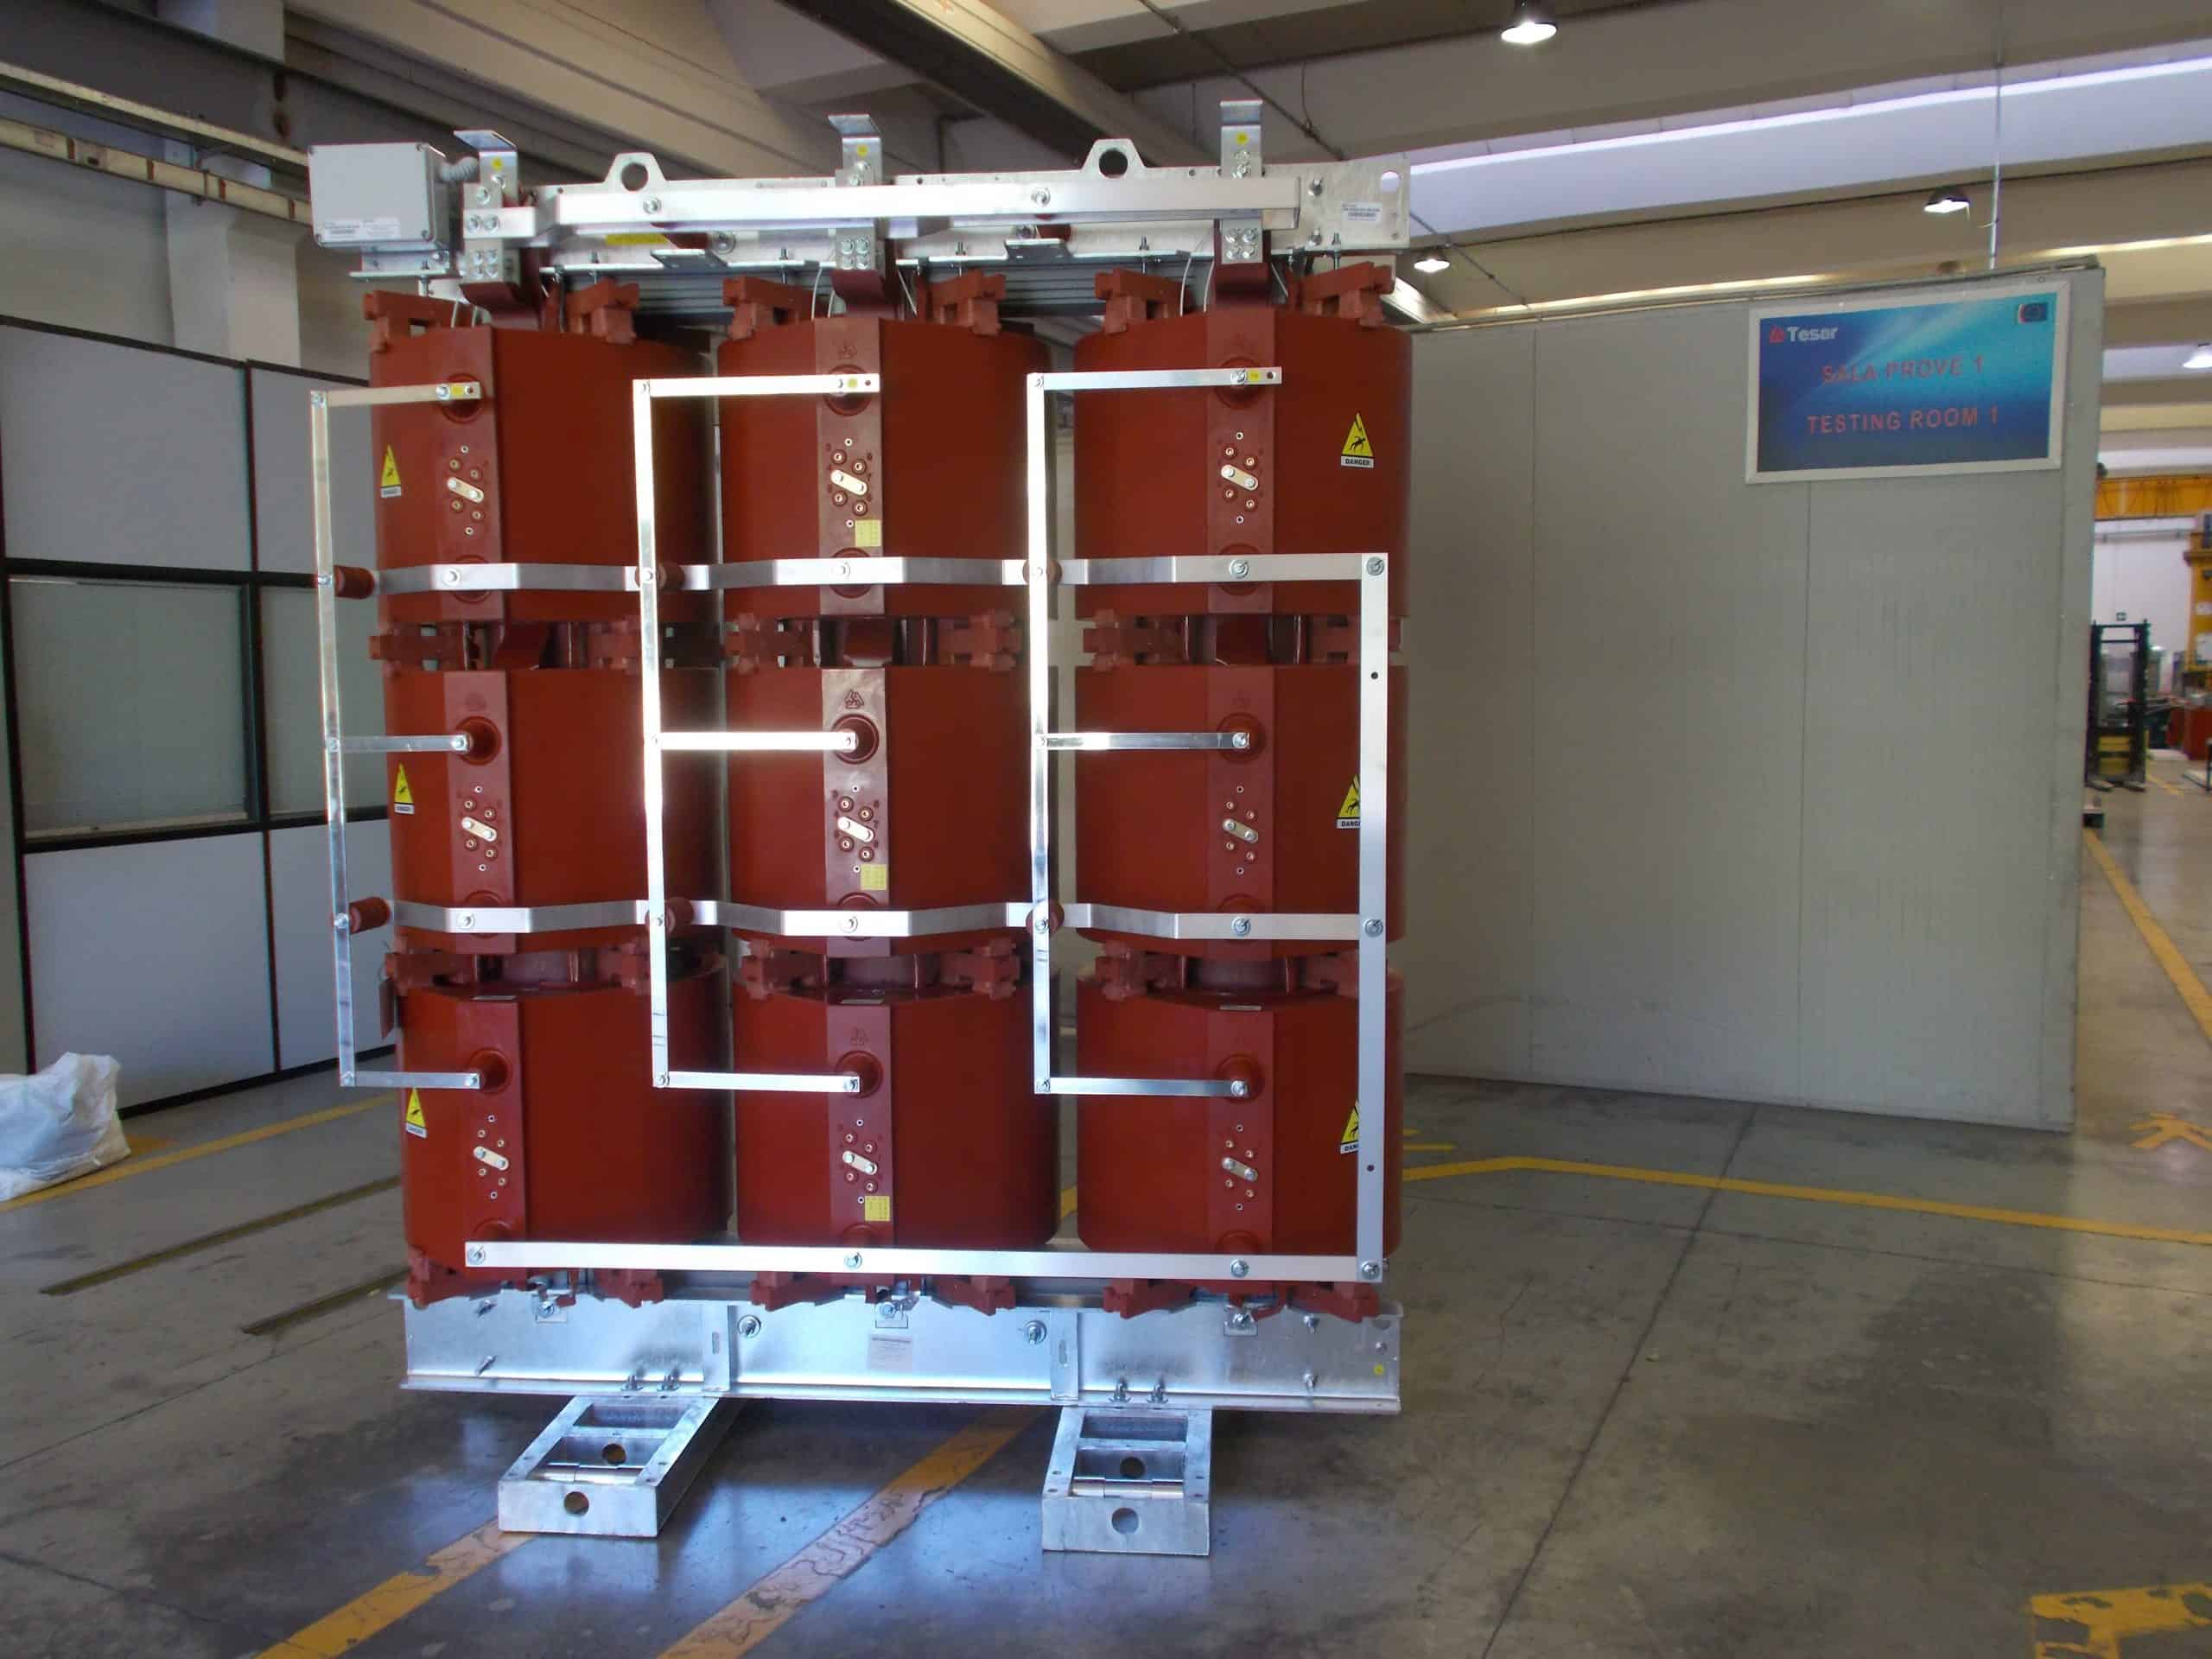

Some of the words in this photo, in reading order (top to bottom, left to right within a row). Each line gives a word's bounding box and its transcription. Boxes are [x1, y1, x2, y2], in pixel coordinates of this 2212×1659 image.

[1821, 363, 1878, 383] SALA
[1885, 356, 1963, 380] PROVE
[1806, 411, 1902, 435] TESTING
[1910, 407, 1979, 429] ROOM
